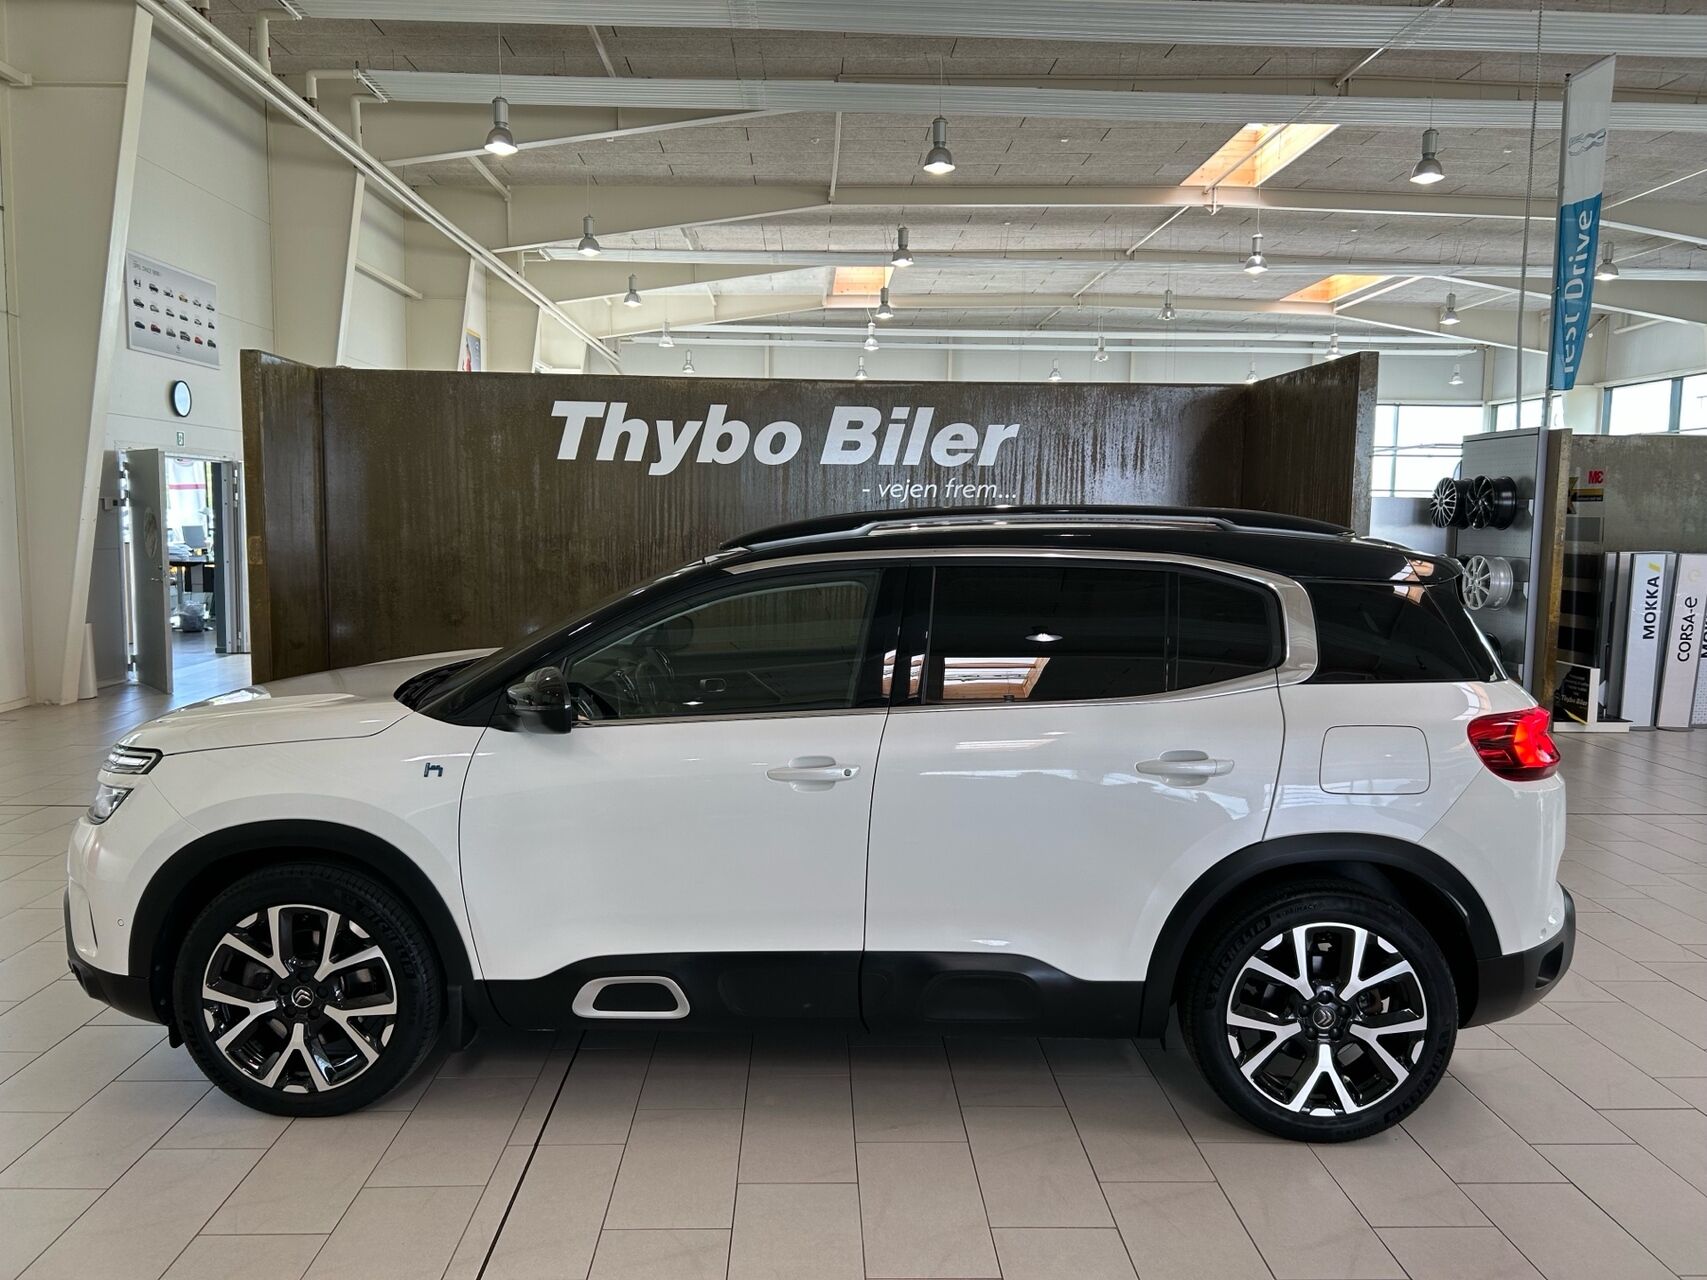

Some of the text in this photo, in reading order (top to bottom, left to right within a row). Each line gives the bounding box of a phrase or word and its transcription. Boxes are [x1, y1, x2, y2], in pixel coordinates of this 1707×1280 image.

[1564, 210, 1593, 300] Drive
[551, 401, 1020, 475] Thybo Biler
[878, 479, 937, 503] vejen
[945, 477, 1017, 499] frem...
[1643, 576, 1660, 640] MOKKA
[1677, 596, 1698, 662] CORSA-e
